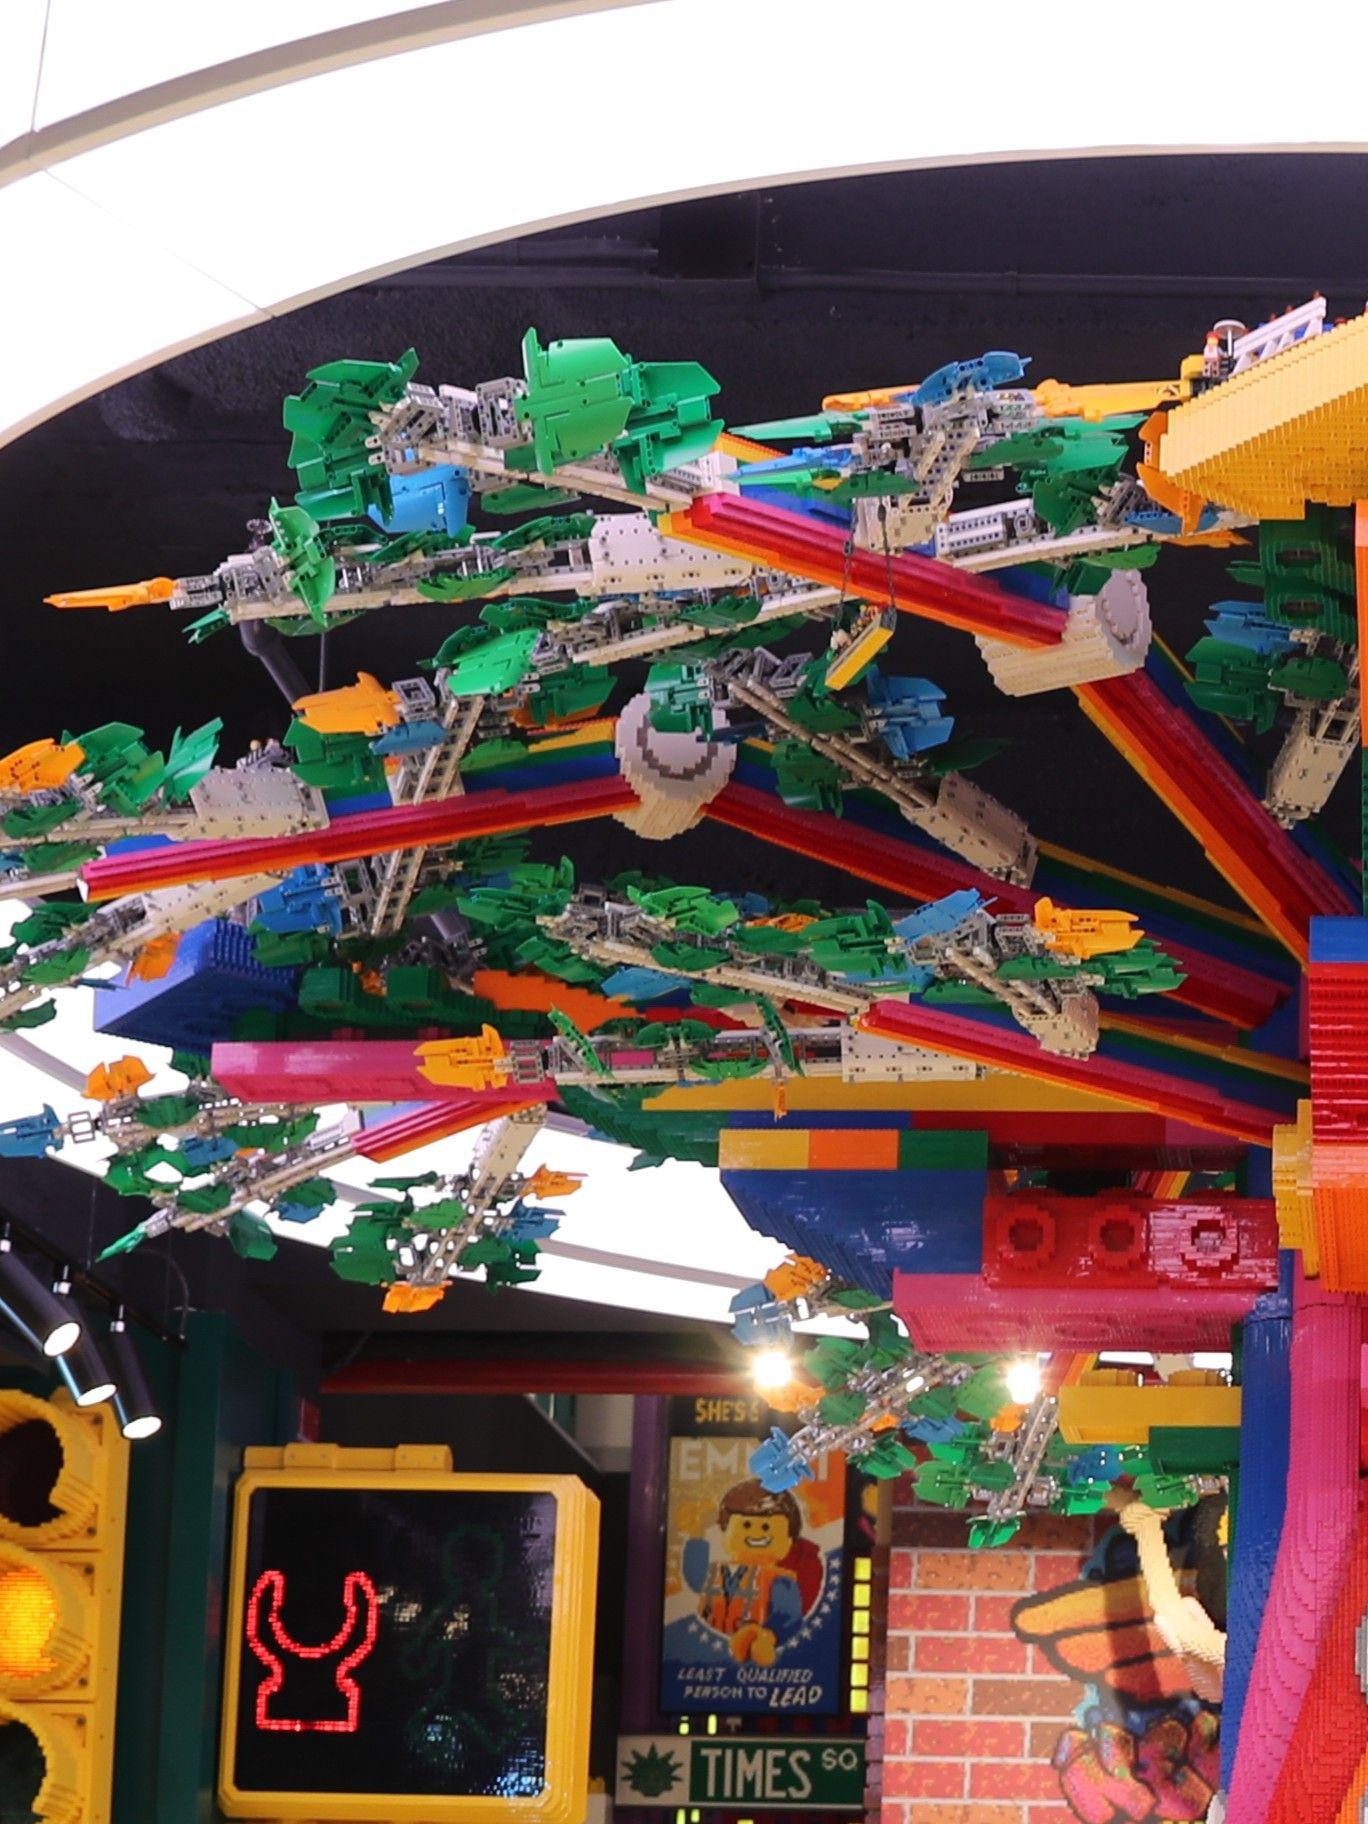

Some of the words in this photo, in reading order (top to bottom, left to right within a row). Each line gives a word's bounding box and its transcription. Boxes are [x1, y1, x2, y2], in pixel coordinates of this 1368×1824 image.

[677, 1668, 726, 1680] LEAST
[737, 1668, 813, 1684] QUALIFIED
[684, 1686, 742, 1699] PERSON
[748, 1687, 767, 1699] TO
[769, 1685, 823, 1708] LEAD
[700, 1748, 812, 1799] TIMES
[821, 1747, 858, 1772] SQ
